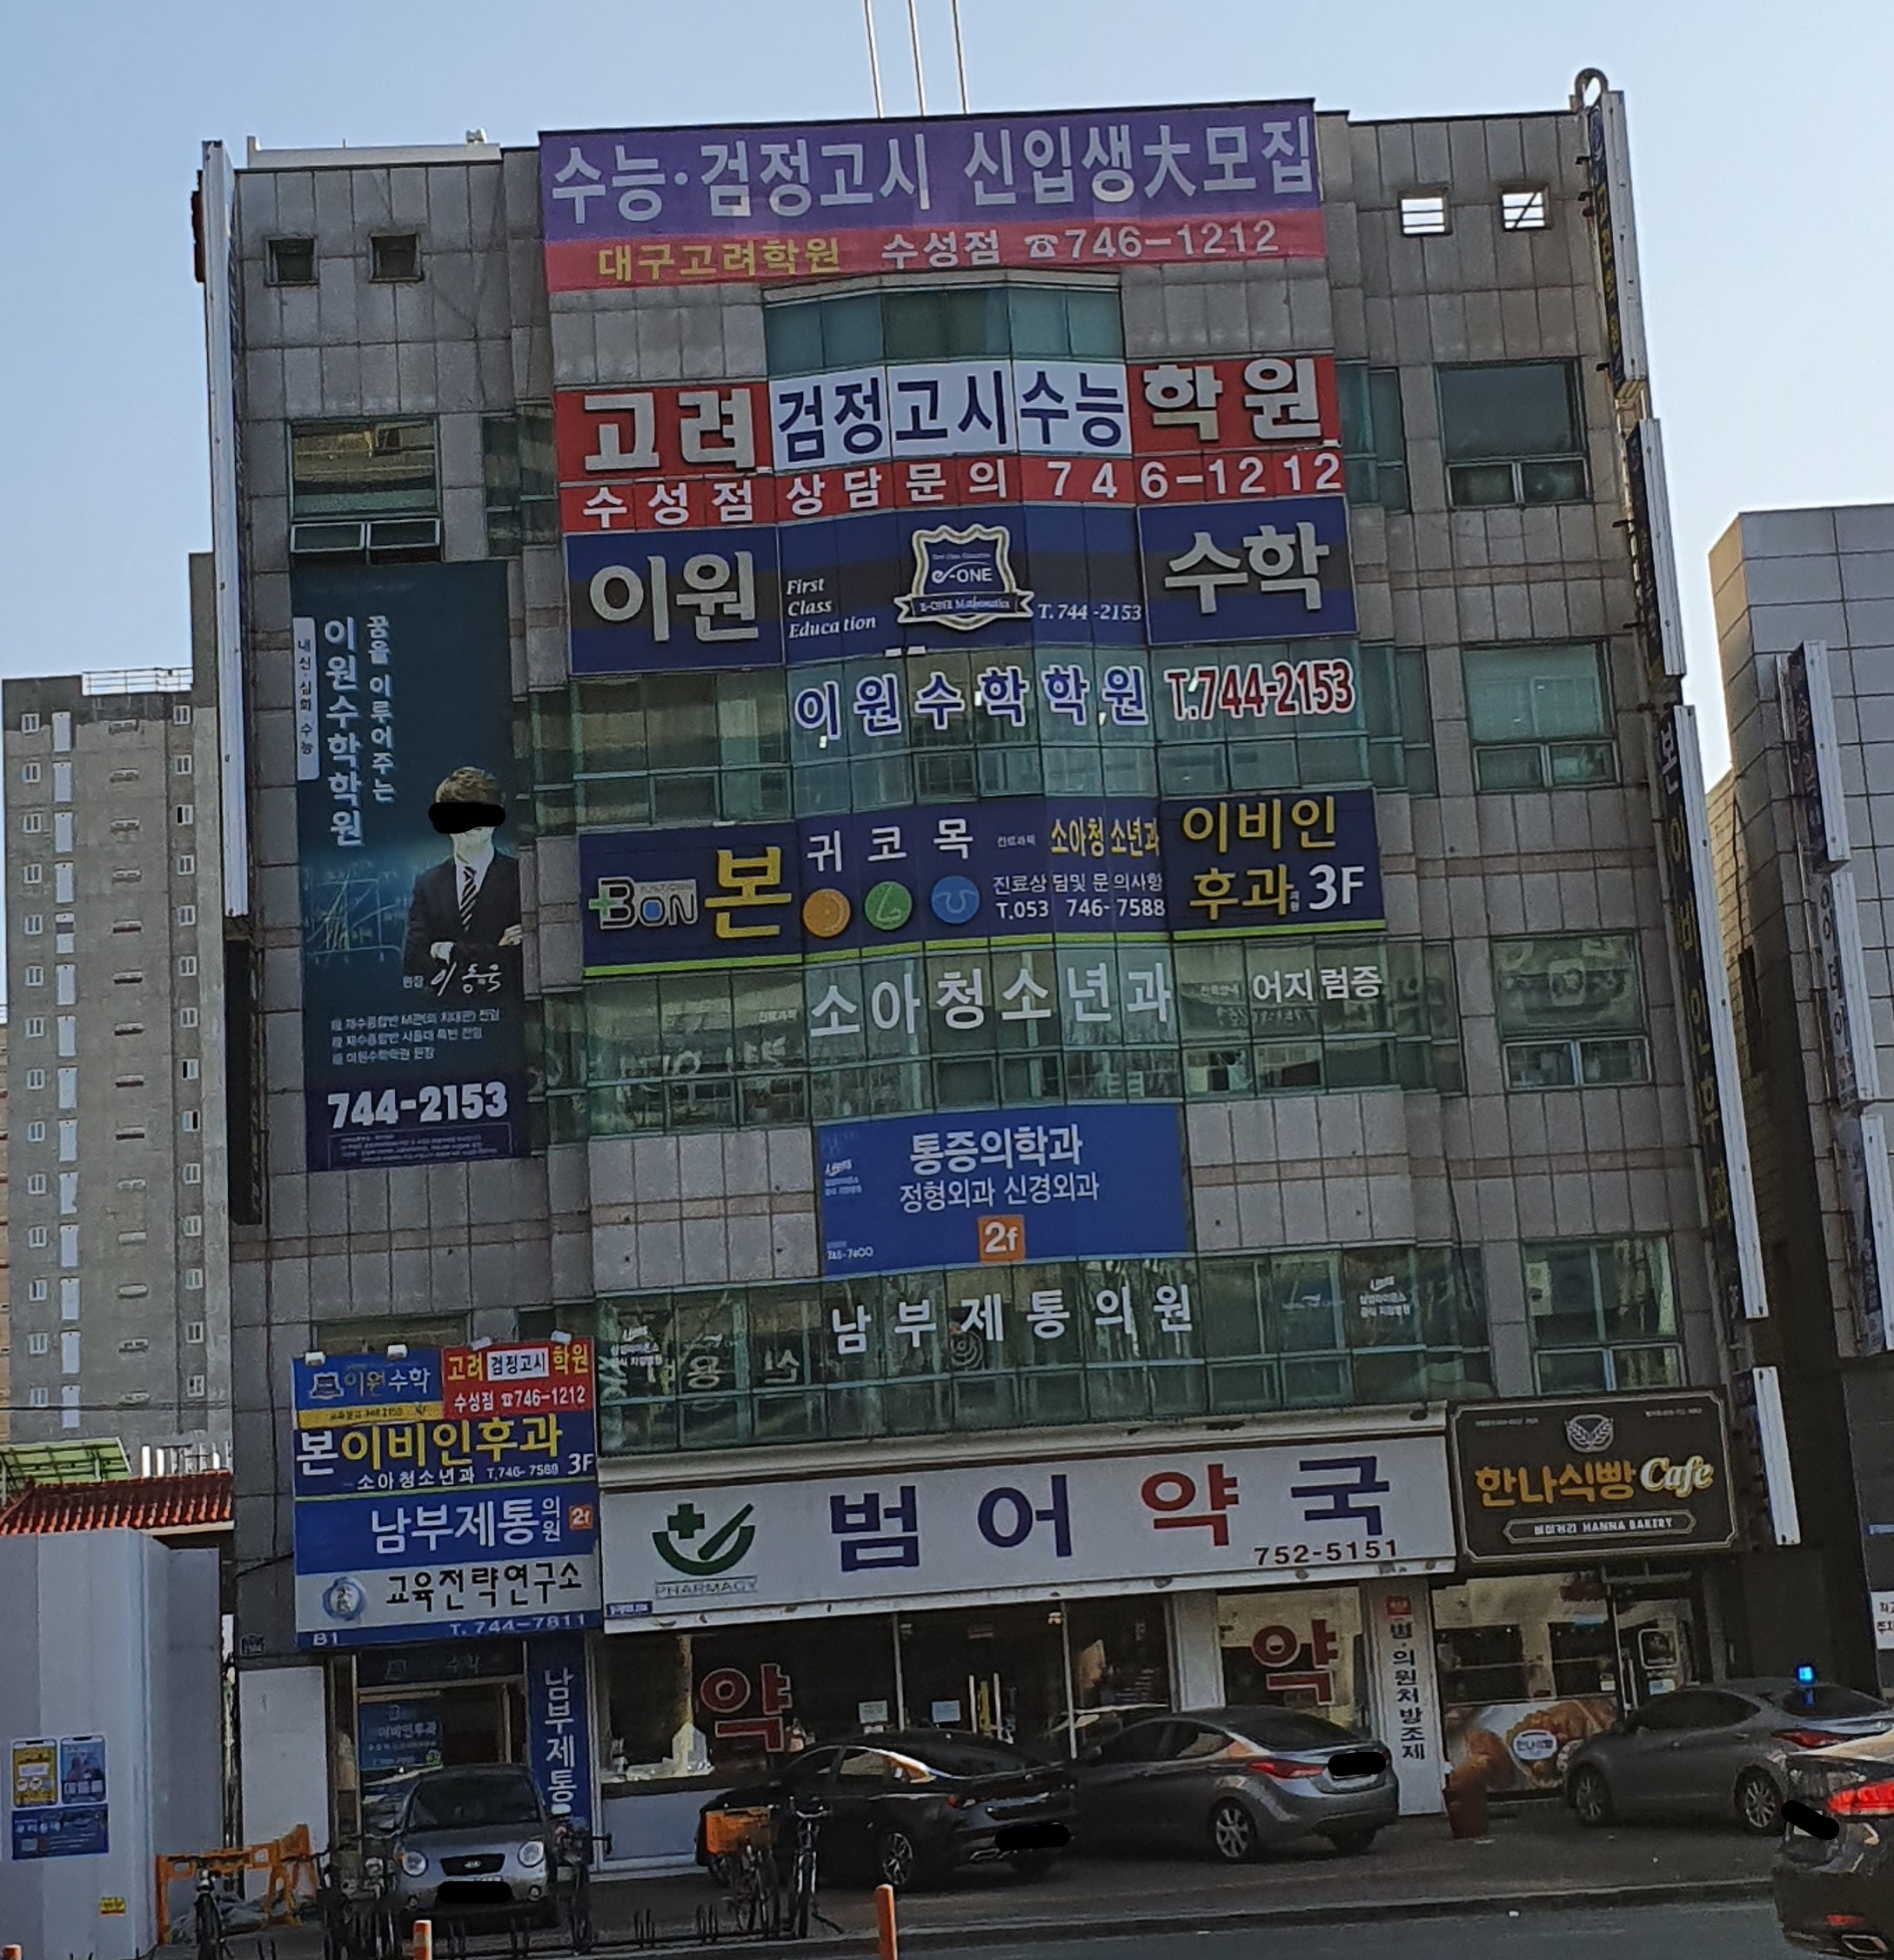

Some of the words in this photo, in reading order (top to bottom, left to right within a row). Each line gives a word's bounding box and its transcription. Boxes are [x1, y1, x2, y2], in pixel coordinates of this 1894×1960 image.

[599, 237, 840, 282] 대구고려학원
[881, 229, 1000, 270] 수성점
[584, 388, 756, 472] 고려
[1142, 358, 1322, 441] 학원
[583, 479, 754, 528] 수성점
[1047, 452, 1342, 498] 746-1212
[589, 551, 759, 642] 이원
[1164, 521, 1330, 613] 수학
[786, 577, 825, 596] First
[787, 599, 833, 617] Class
[788, 614, 877, 639] Education
[1164, 658, 1355, 722] T.744-2153
[806, 829, 843, 872] 귀
[867, 826, 907, 862] 코
[933, 818, 974, 860] 목
[1182, 796, 1337, 853] 이비인
[704, 846, 793, 939] 본
[995, 900, 1049, 920] T.053
[1308, 862, 1365, 911] 3F
[809, 962, 1172, 1037] 소아청소년과
[1252, 966, 1383, 1003] 어지럼증
[327, 1081, 509, 1128] 744-2153
[909, 1123, 1083, 1176] 통증의학과
[899, 1177, 995, 1214] 정형외과
[1004, 1172, 1100, 1206] 신경외과
[453, 1390, 494, 1413] 수성점
[357, 1467, 476, 1491] 소아청소년과
[567, 1453, 593, 1475] 3F
[1475, 1460, 1636, 1508] 한나식빵
[1640, 1455, 1714, 1498] Cafe
[371, 1498, 539, 1554] 남부제통
[1254, 1539, 1397, 1566] 752-5151
[386, 1562, 582, 1612] 교육전략연구소
[313, 1632, 338, 1646] B1
[1251, 1617, 1339, 1706] 약
[699, 1662, 792, 1753] 약
